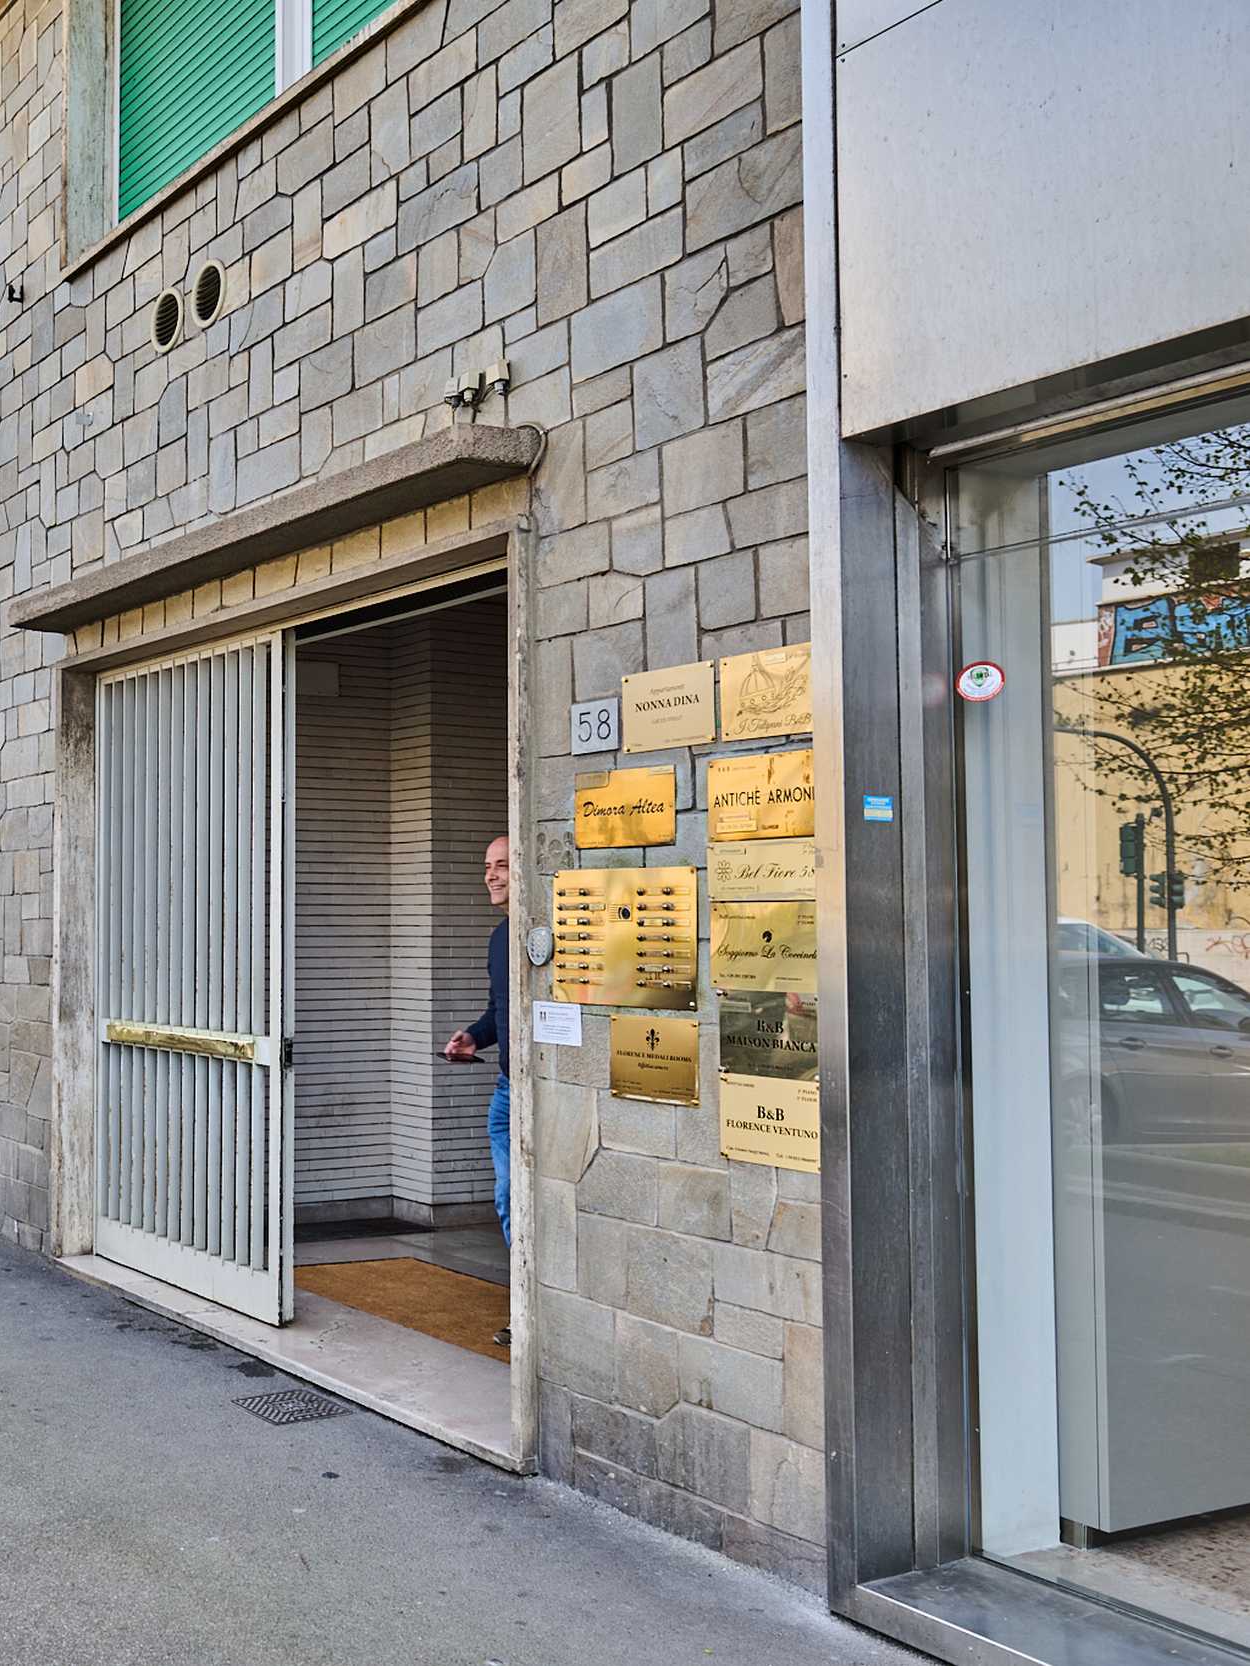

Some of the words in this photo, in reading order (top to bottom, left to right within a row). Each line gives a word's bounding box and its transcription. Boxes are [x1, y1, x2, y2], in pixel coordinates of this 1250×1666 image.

[635, 699, 671, 712] NONNA
[674, 694, 700, 707] DINA
[578, 709, 612, 742] 58
[583, 801, 625, 817] Dimora
[630, 798, 664, 816] Altea
[735, 864, 760, 880] Bel
[763, 862, 795, 879] Fiore
[757, 1020, 784, 1034] B&B
[726, 1035, 772, 1049] MAISON
[772, 1039, 817, 1053] BIANCA
[757, 1105, 785, 1122] B&B
[726, 1118, 771, 1134] FLORENCE
[773, 1125, 819, 1140] VENTUNO
